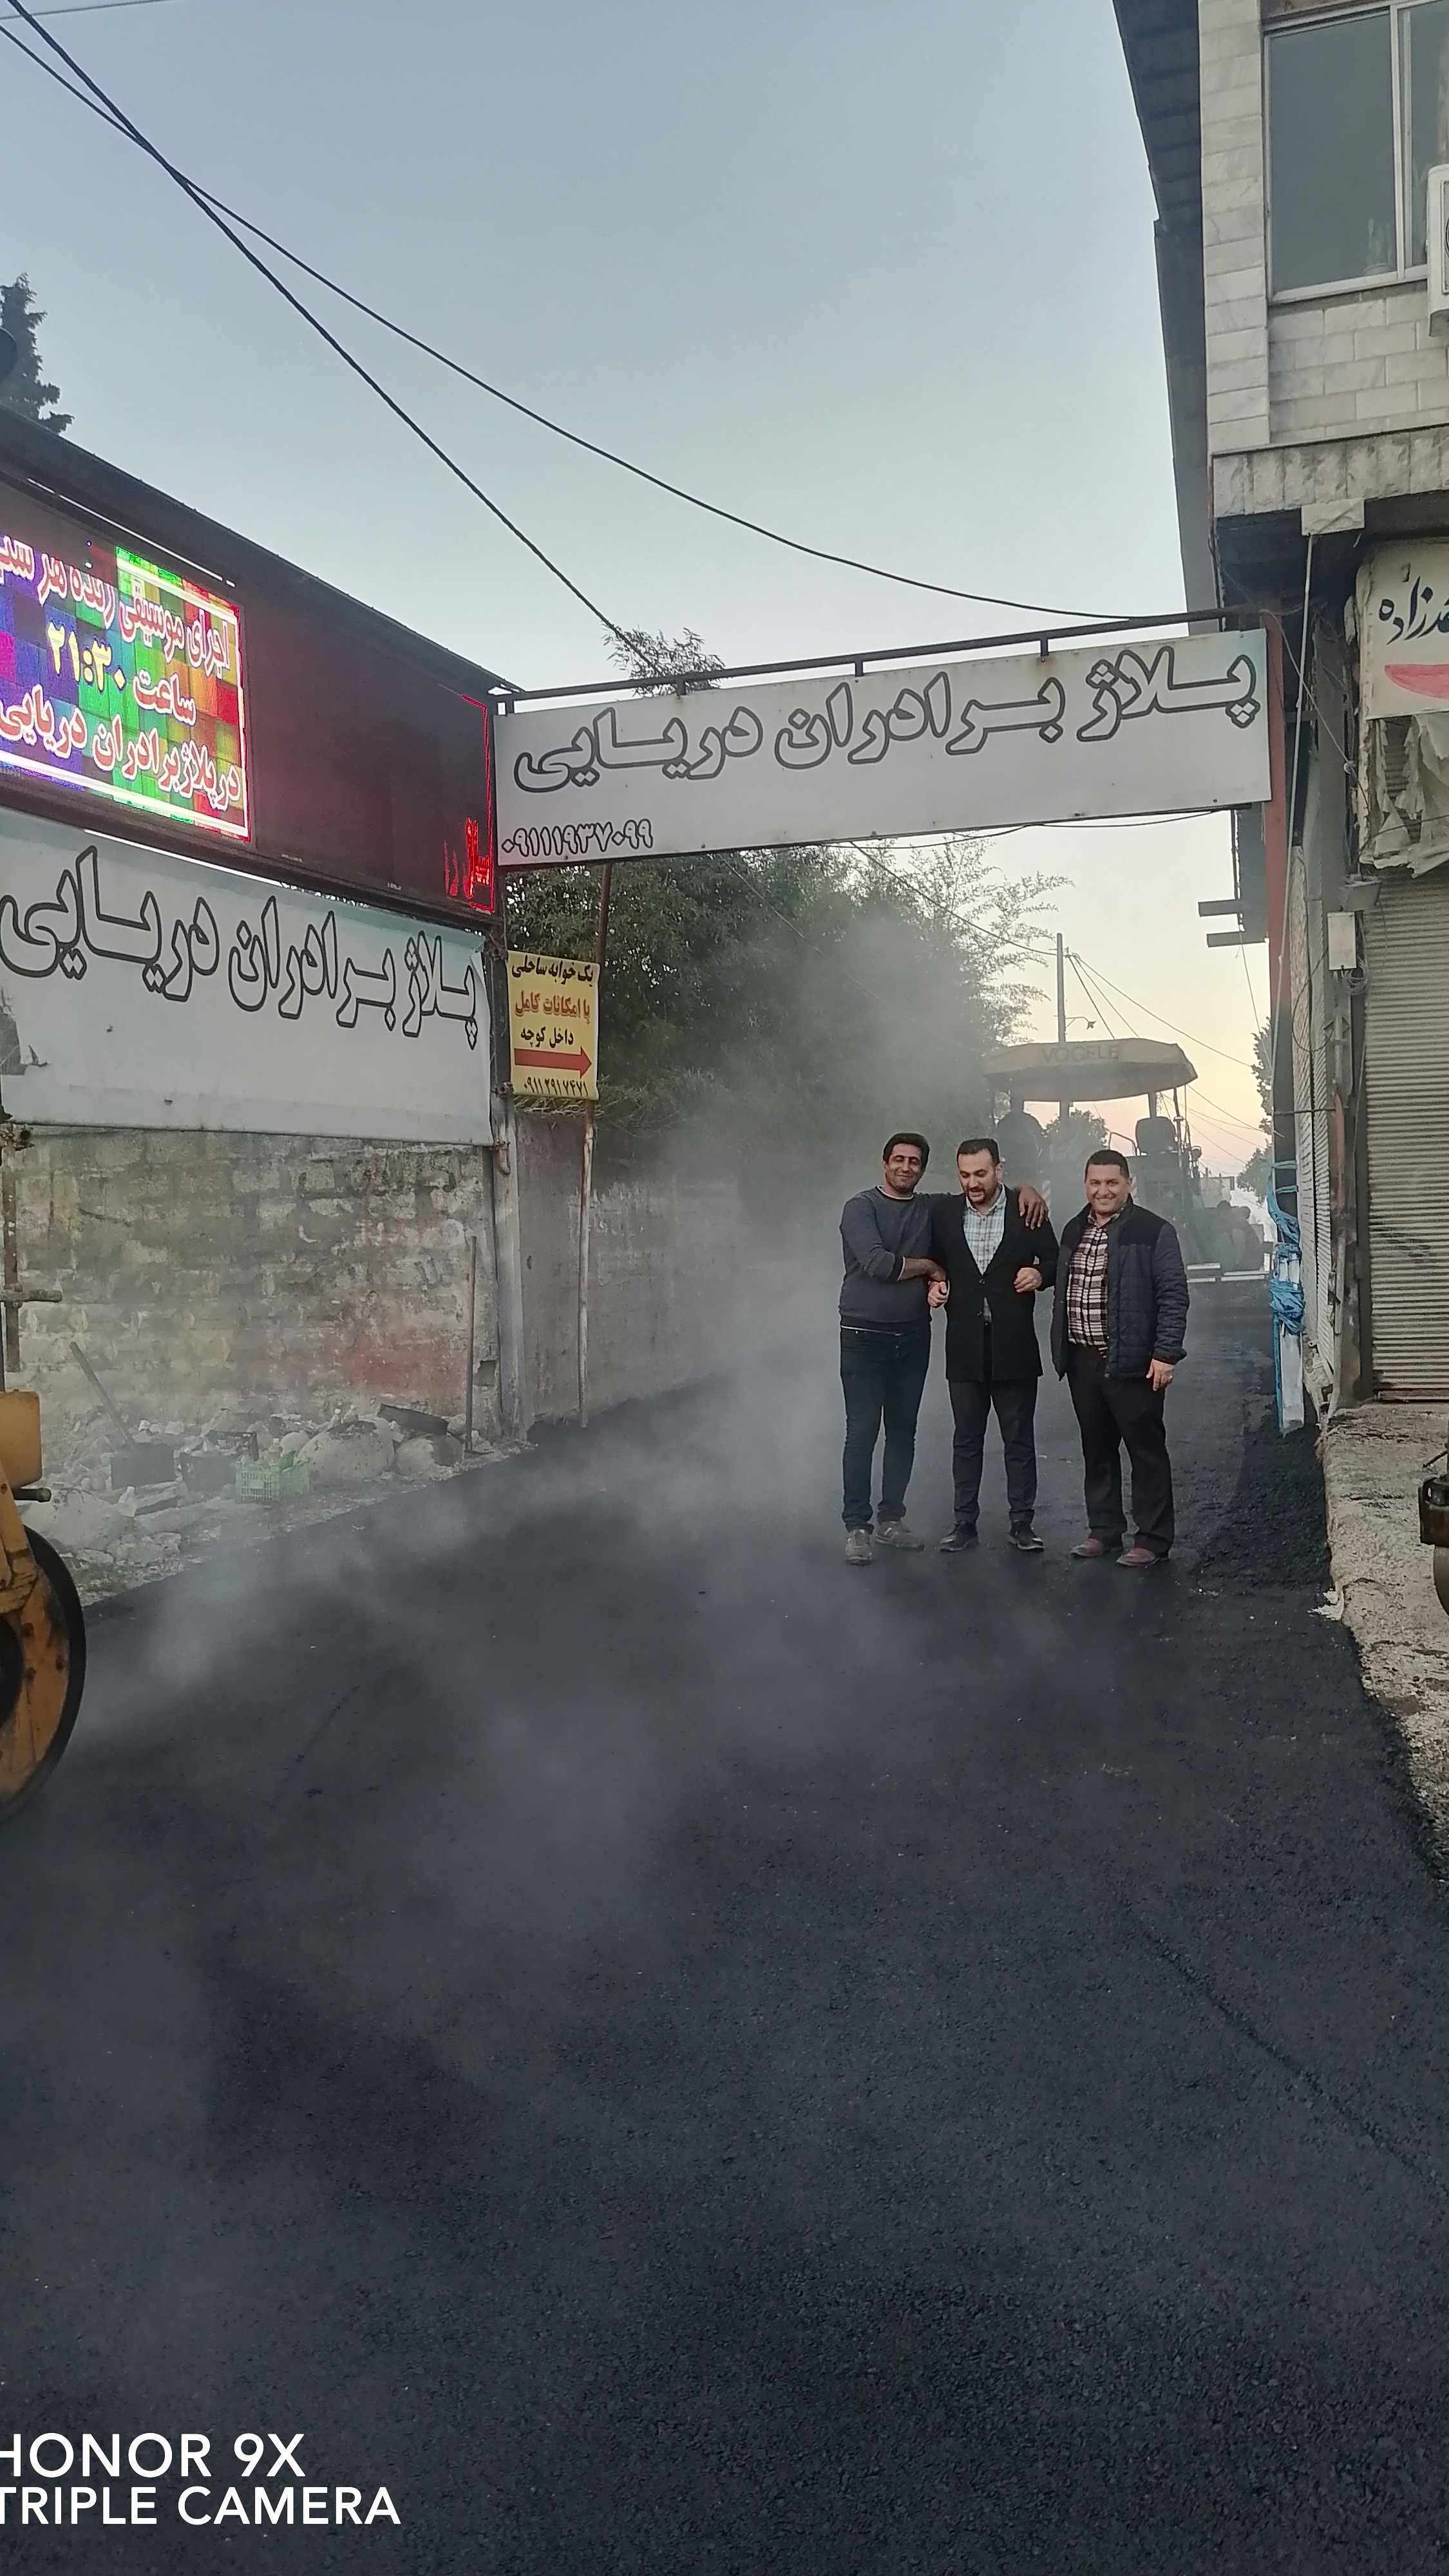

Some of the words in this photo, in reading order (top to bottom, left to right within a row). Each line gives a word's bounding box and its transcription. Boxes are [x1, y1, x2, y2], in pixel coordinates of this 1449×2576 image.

[118, 575, 185, 664] موسیقی
[186, 607, 230, 680] اجرای
[47, 621, 126, 692] ۲۱:۳۰
[133, 666, 196, 726] ساعت
[773, 672, 1066, 770] برادران
[1076, 646, 1258, 742] پلاژ
[513, 705, 764, 795] دریایی
[500, 819, 653, 857] ۰۹۱۱۱۹۳۷۰۹۹
[0, 845, 220, 1002] دریایی
[228, 895, 397, 1032] برادران
[402, 931, 478, 1050] پلاژ
[512, 954, 547, 978] ساحلی
[547, 960, 576, 985] خوابه
[577, 964, 594, 987] یک
[515, 990, 541, 1018] کامل
[543, 994, 581, 1019] امکانات
[520, 1026, 546, 1048] کوچه
[549, 1027, 574, 1048] داخل
